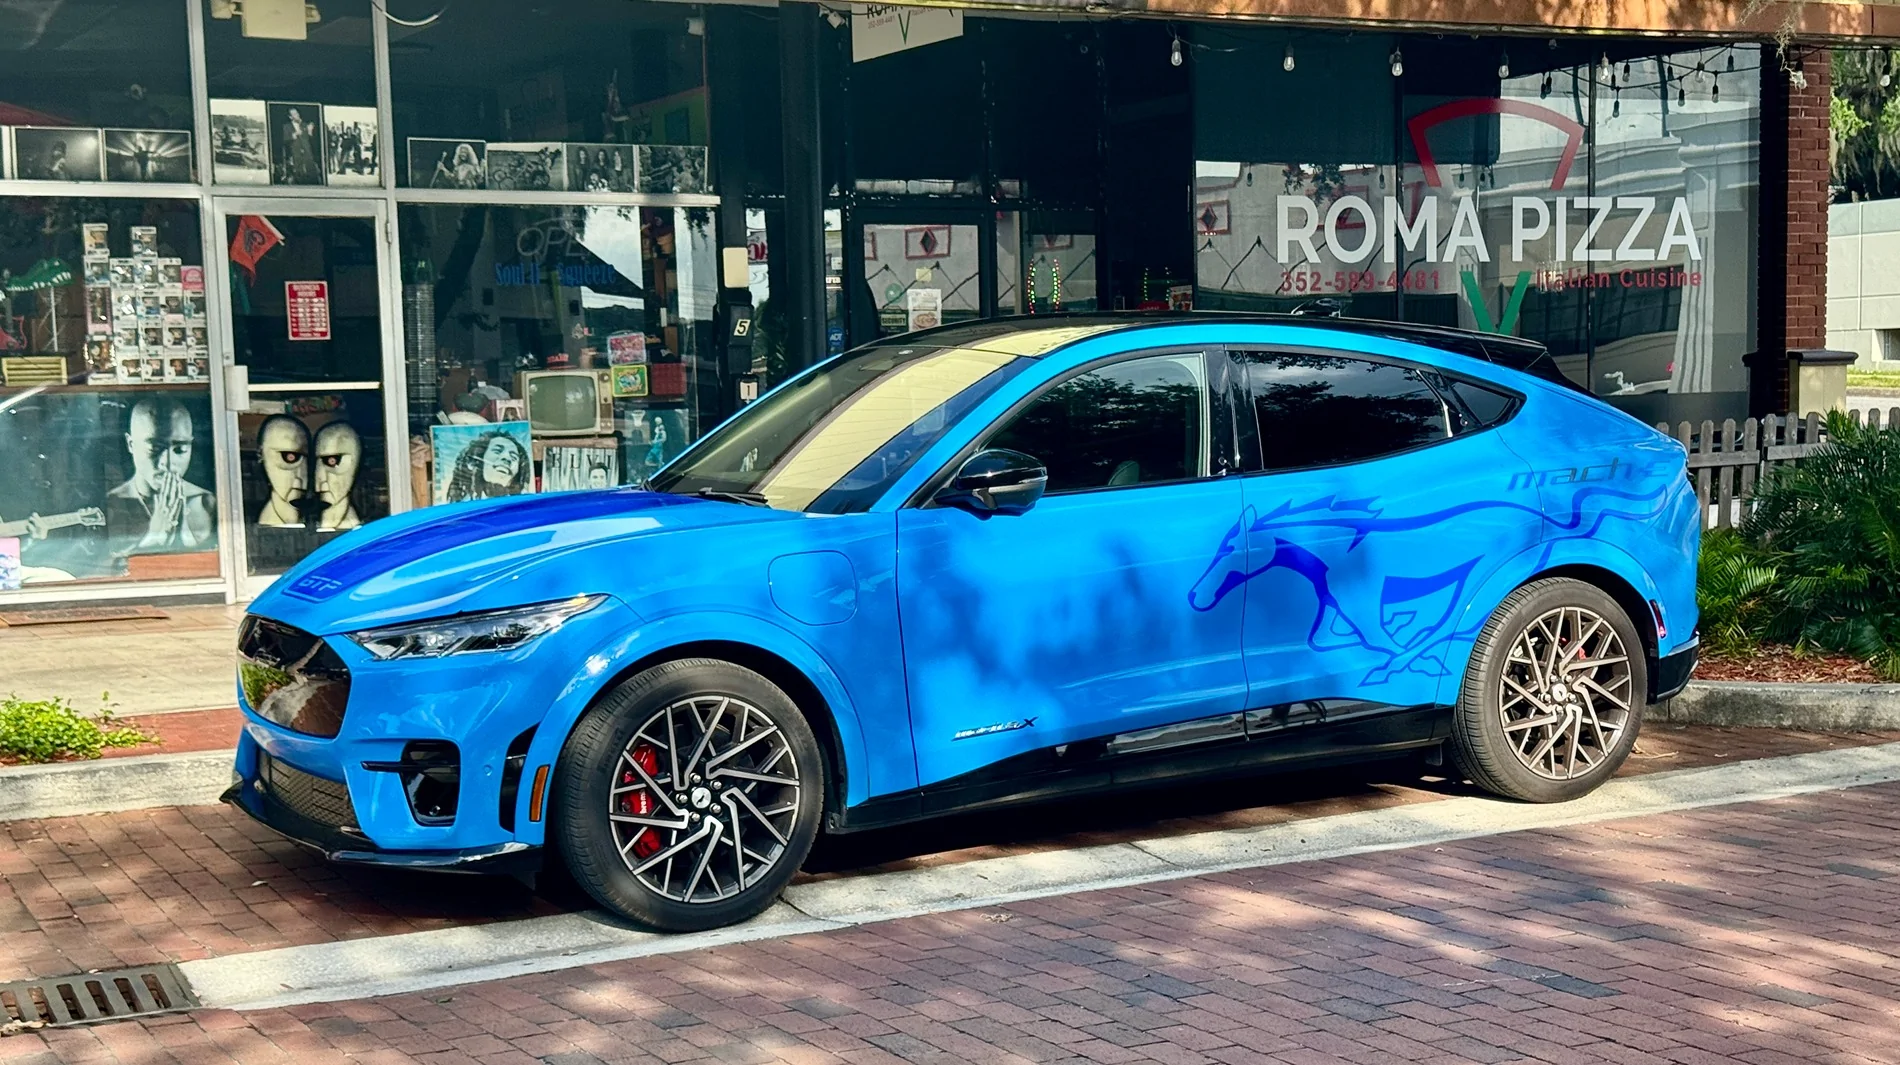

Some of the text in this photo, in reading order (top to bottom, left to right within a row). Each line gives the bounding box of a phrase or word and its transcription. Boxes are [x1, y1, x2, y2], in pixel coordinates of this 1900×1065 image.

[1276, 195, 1702, 264] ROMA PIZZA
[1281, 270, 1440, 292] 352-589-4481
[1536, 266, 1703, 289] Italian Cuisine
[736, 320, 749, 335] 5
